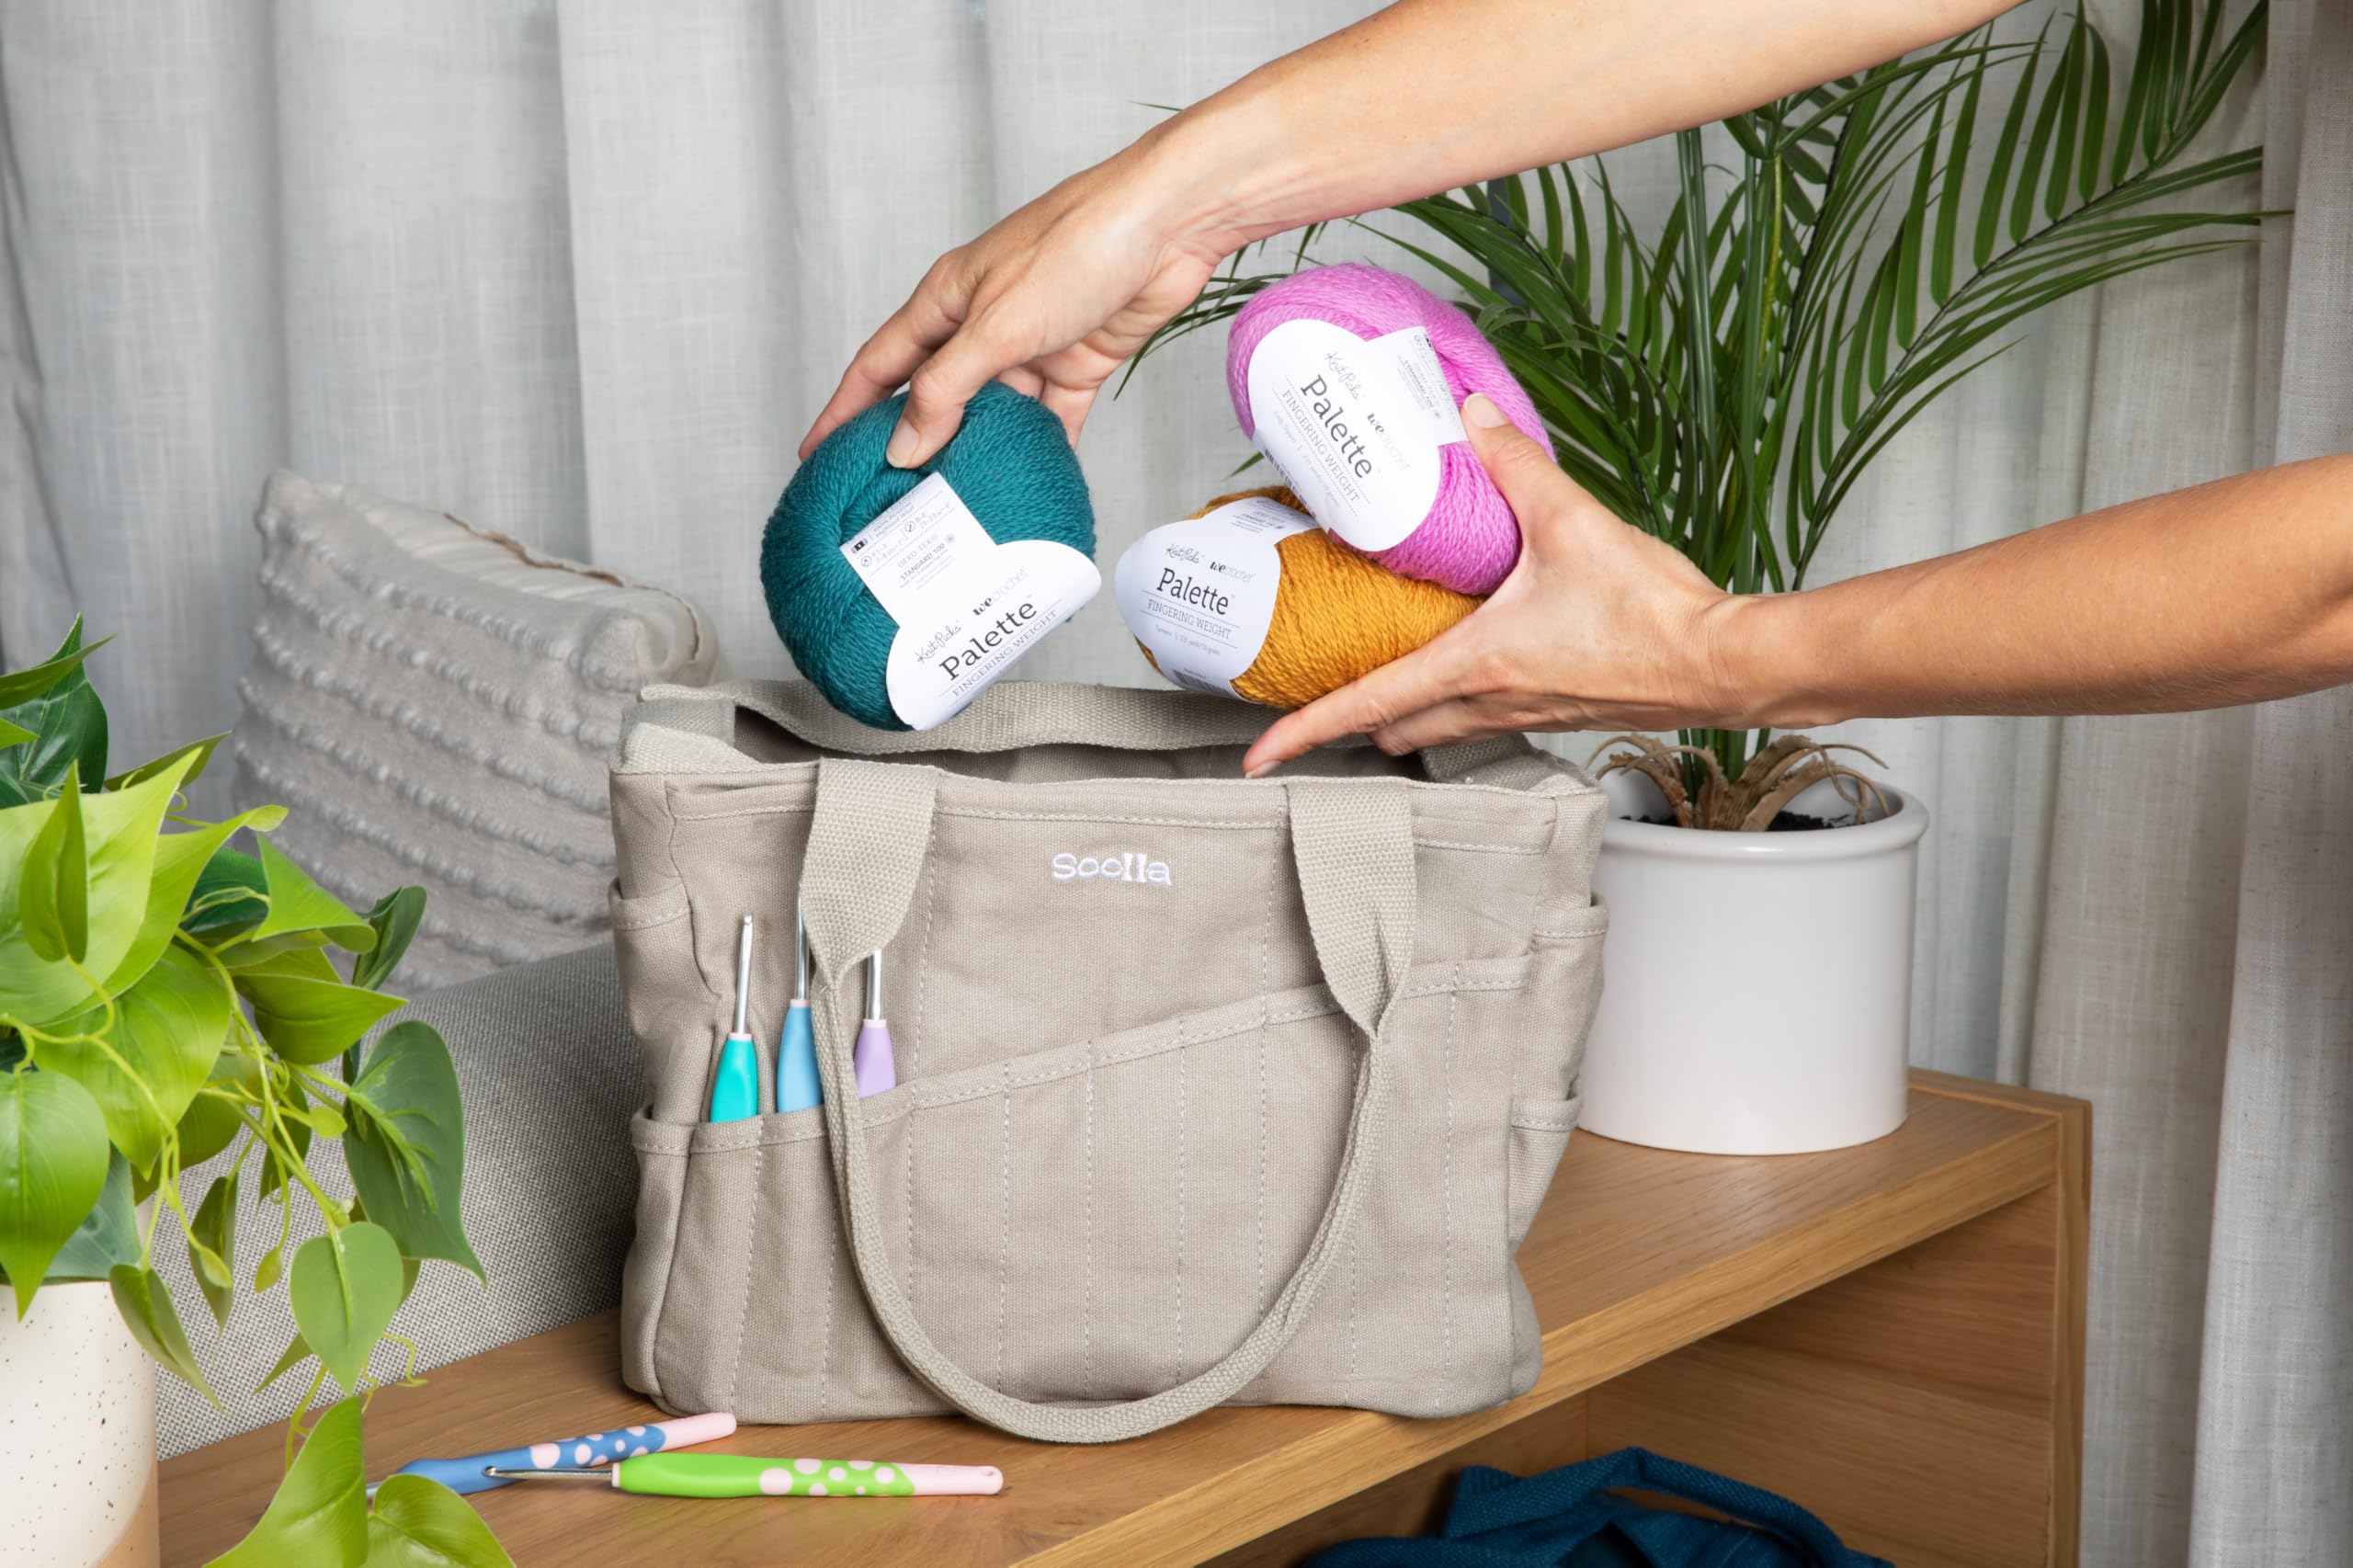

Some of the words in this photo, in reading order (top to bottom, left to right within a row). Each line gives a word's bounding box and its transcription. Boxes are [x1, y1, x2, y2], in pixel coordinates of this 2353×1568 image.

[1282, 390, 1326, 456] FINGERING
[1324, 450, 1360, 502] WEIGHT
[1301, 374, 1372, 479] Palette
[900, 552, 933, 581] STANDARD
[1156, 567, 1229, 615] Palette
[938, 603, 1037, 681] Palette
[1148, 599, 1195, 626] FINGERING
[1196, 618, 1232, 640] WEIGHT
[952, 646, 1014, 698] FINGERING
[1015, 609, 1059, 649] WEIGHT
[1052, 852, 1172, 886] Soolla
